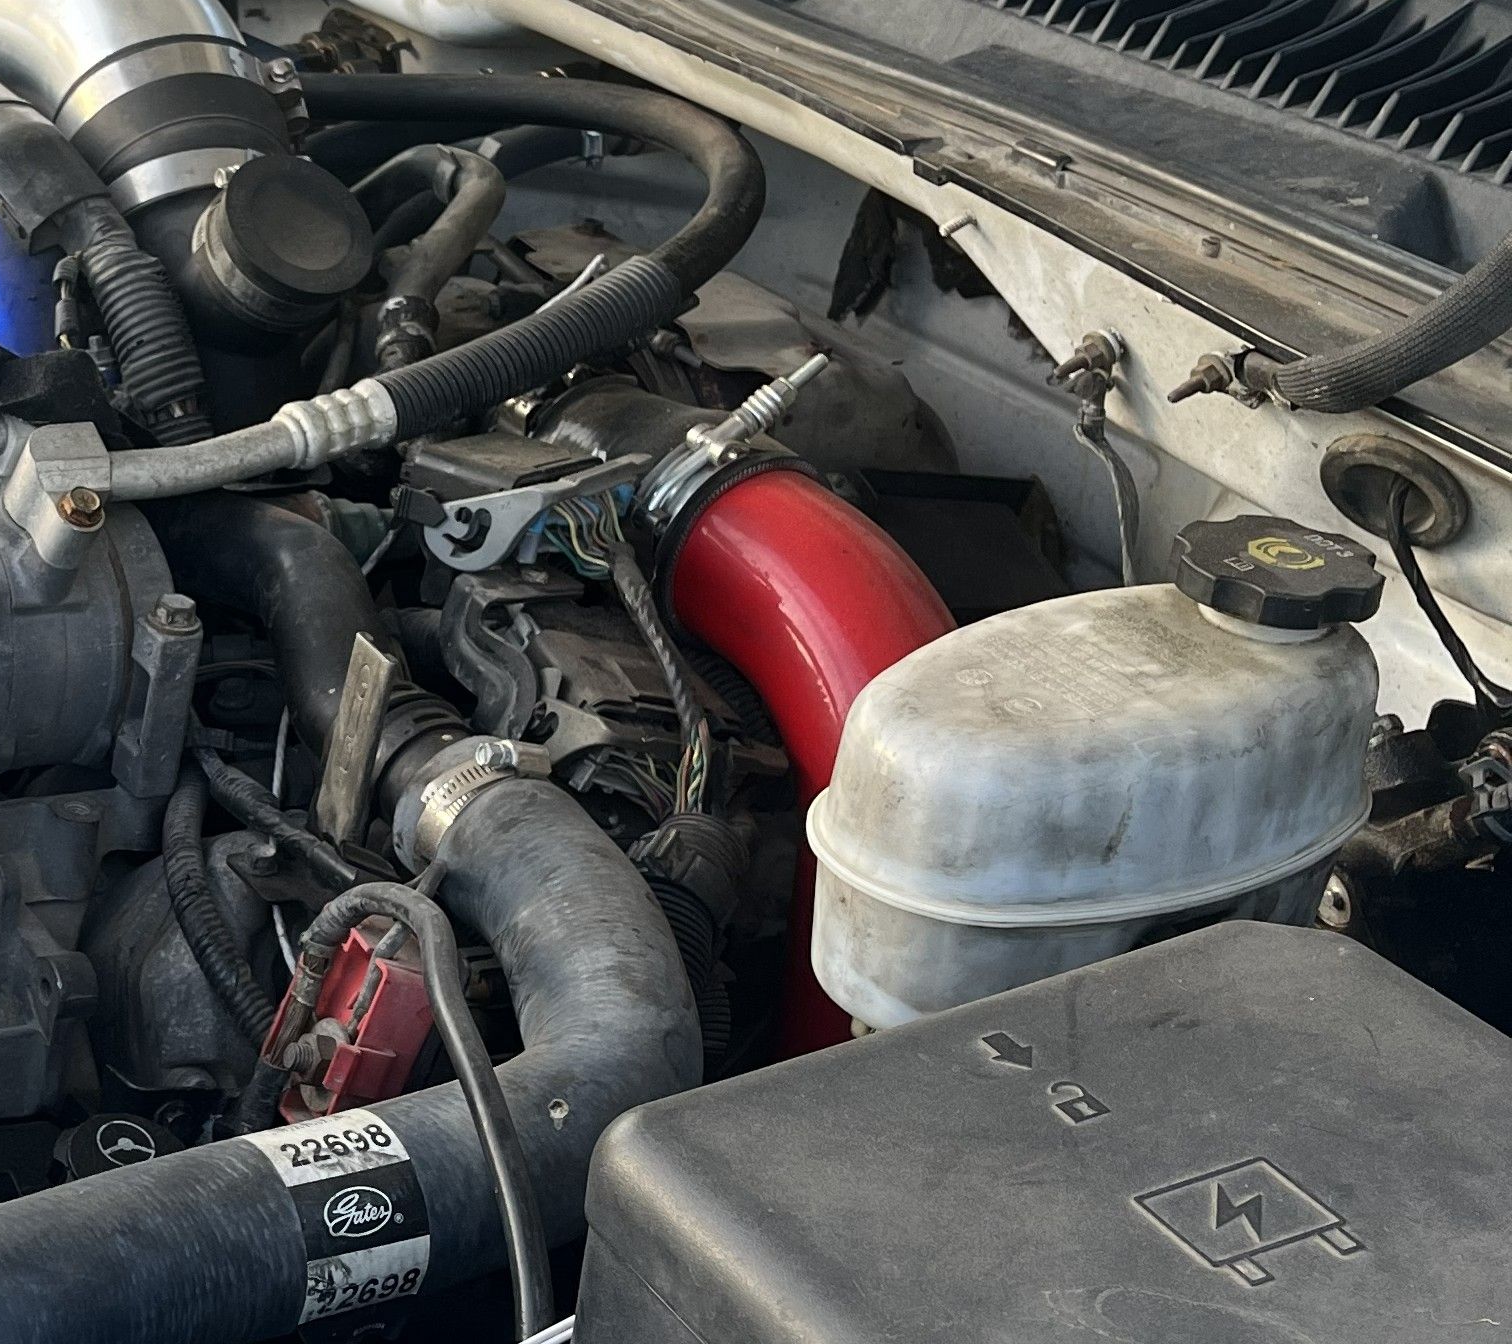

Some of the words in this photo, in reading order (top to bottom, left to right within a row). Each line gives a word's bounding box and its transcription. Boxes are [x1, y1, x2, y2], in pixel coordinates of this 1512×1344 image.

[1303, 534, 1341, 555] DOT
[1339, 547, 1355, 559] 3
[280, 1123, 393, 1168] 22698
[329, 1191, 390, 1237] Gates
